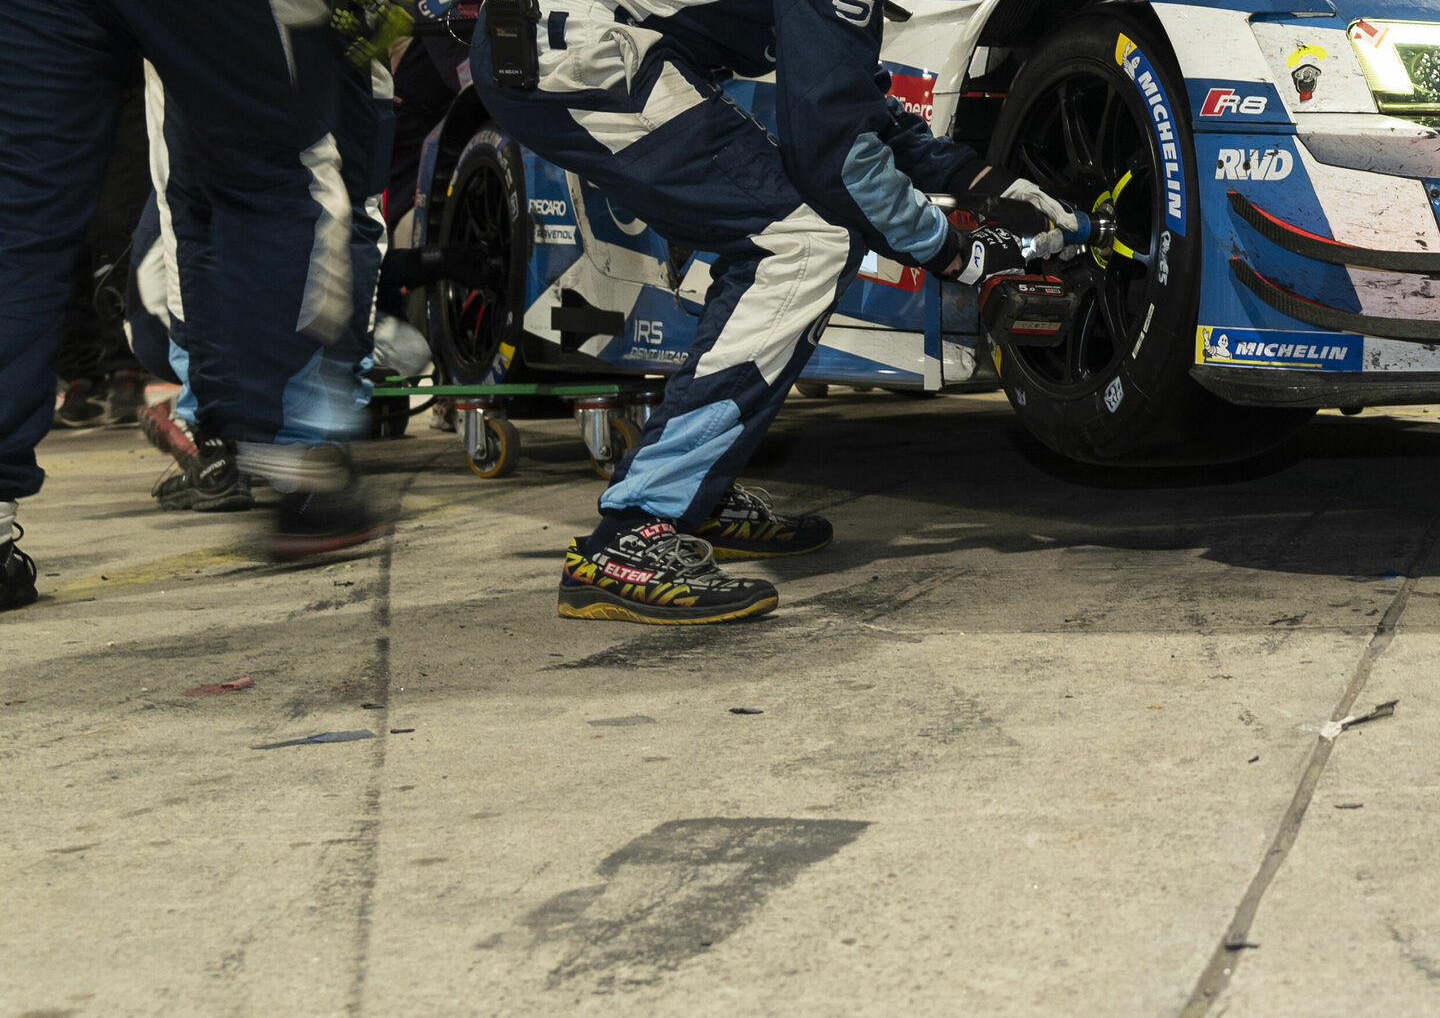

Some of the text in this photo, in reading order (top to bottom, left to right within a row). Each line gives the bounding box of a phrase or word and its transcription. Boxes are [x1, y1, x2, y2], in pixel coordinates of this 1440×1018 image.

[1203, 89, 1268, 116] R8
[1137, 70, 1183, 219] MICHELIN
[1215, 148, 1294, 181] RWD
[528, 198, 567, 217] RECARO
[633, 320, 663, 345] IRS
[1235, 341, 1348, 361] MICHELIN
[604, 563, 653, 582] ELTEN
